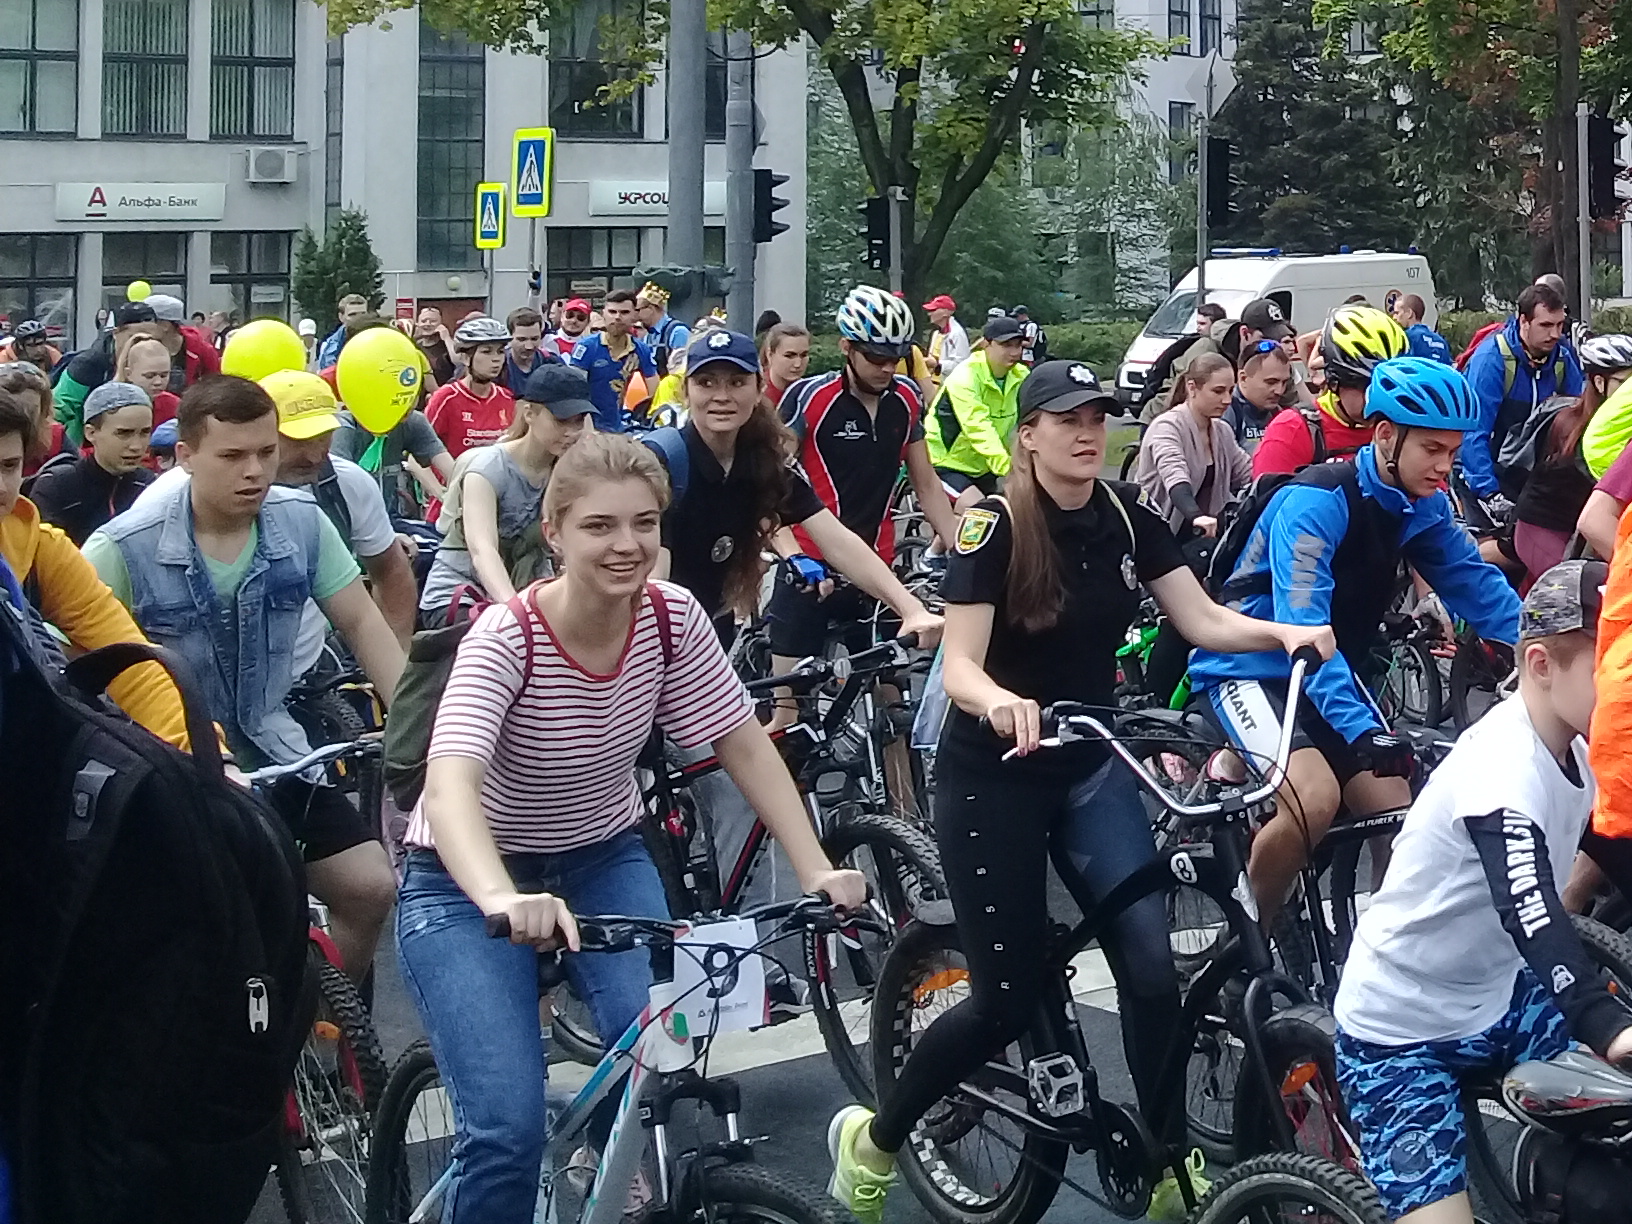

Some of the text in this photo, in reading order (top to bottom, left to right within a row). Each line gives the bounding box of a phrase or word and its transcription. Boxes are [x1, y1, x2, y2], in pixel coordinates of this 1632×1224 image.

[118, 196, 198, 208] Альфа-Банк
[1227, 680, 1258, 731] GIANT
[1515, 889, 1551, 938] THE
[703, 942, 740, 999] 9
